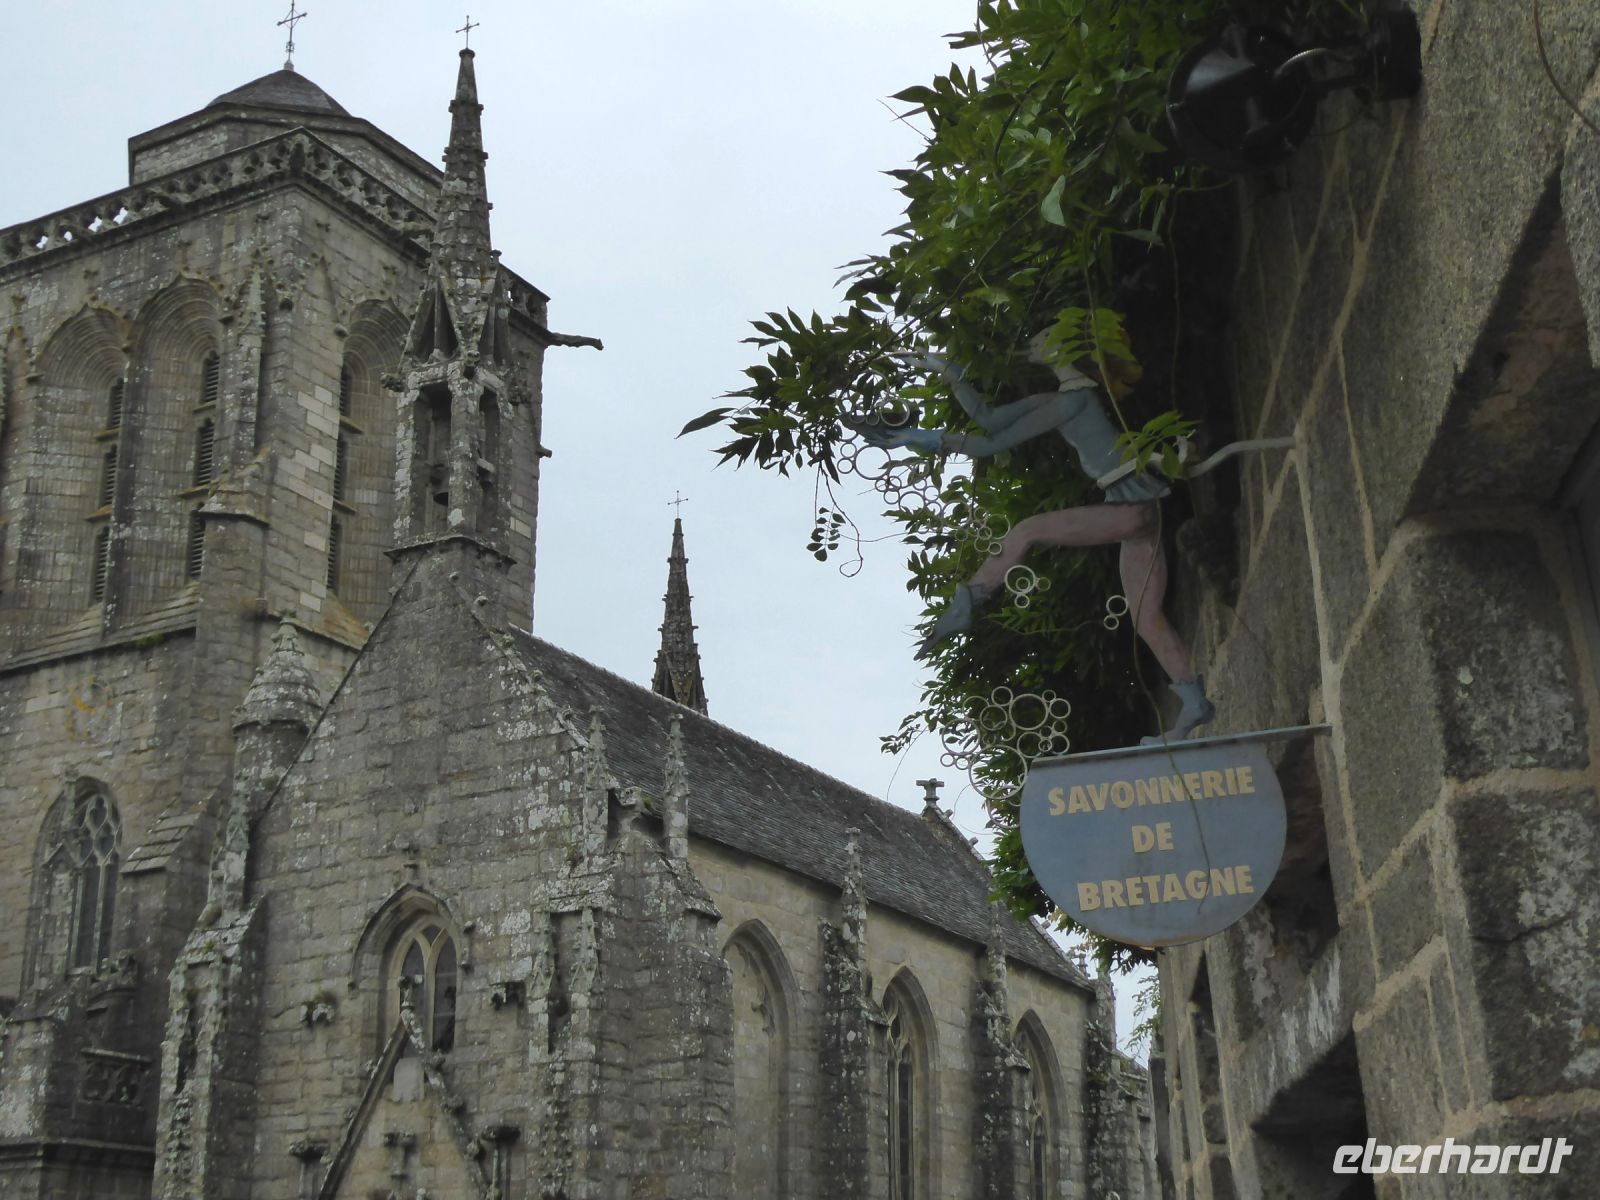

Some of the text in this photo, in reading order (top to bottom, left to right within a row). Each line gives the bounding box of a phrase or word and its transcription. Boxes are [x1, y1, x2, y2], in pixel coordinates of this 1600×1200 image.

[1048, 766, 1255, 816] SAVONNERIE
[1131, 822, 1174, 853] DE
[1077, 865, 1254, 911] BRETAGNE
